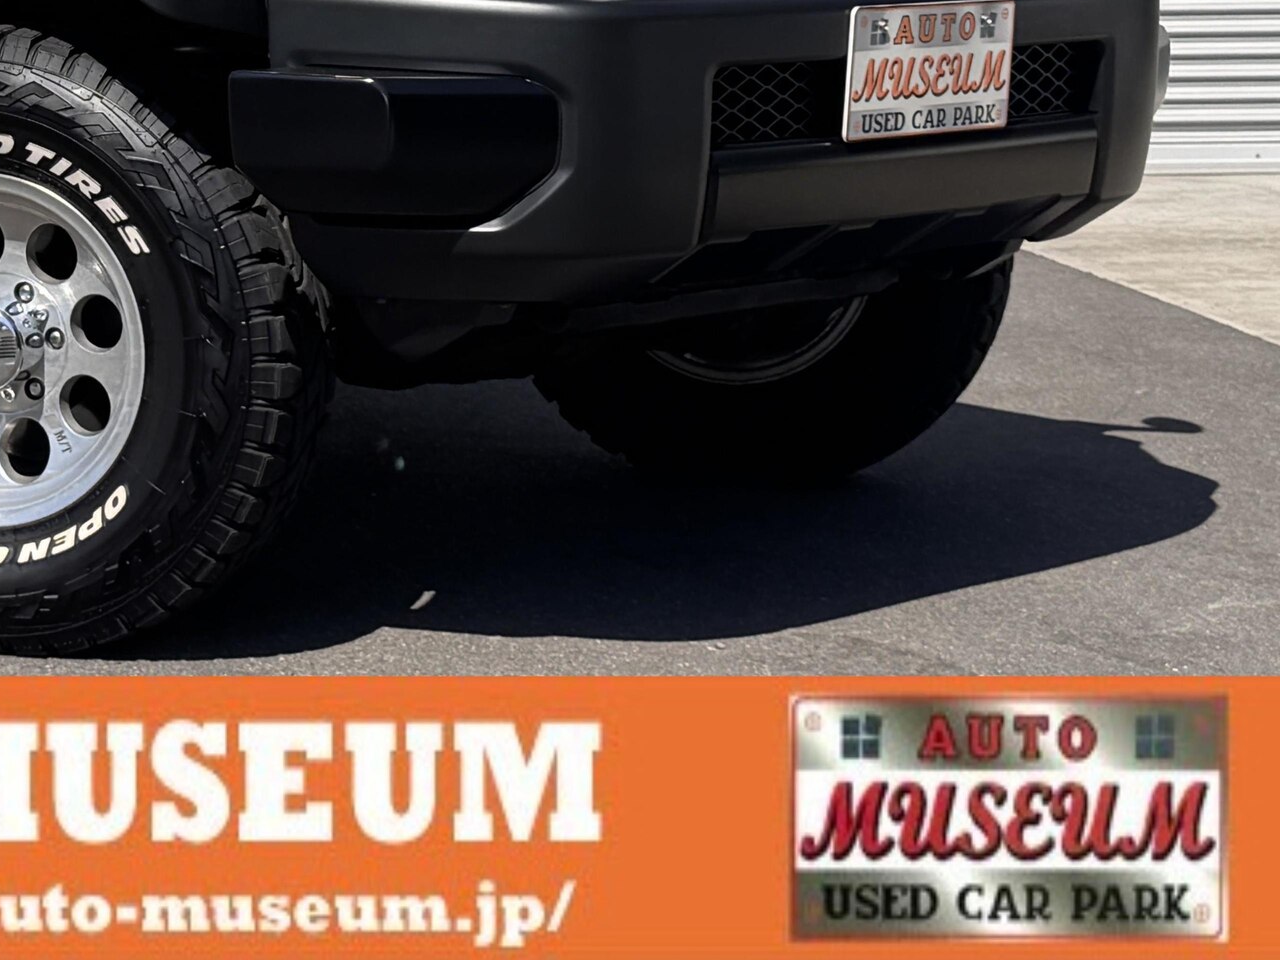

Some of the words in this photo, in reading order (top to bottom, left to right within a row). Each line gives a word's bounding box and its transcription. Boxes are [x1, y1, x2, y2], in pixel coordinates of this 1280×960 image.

[893, 11, 976, 45] AUTO
[851, 49, 1006, 103] MUSEUM
[861, 111, 905, 133] USED
[911, 108, 946, 129] CAR
[952, 104, 996, 126] PARK
[25, 142, 151, 255] TIRES
[53, 430, 72, 453] M/T
[17, 484, 129, 565] OPEN
